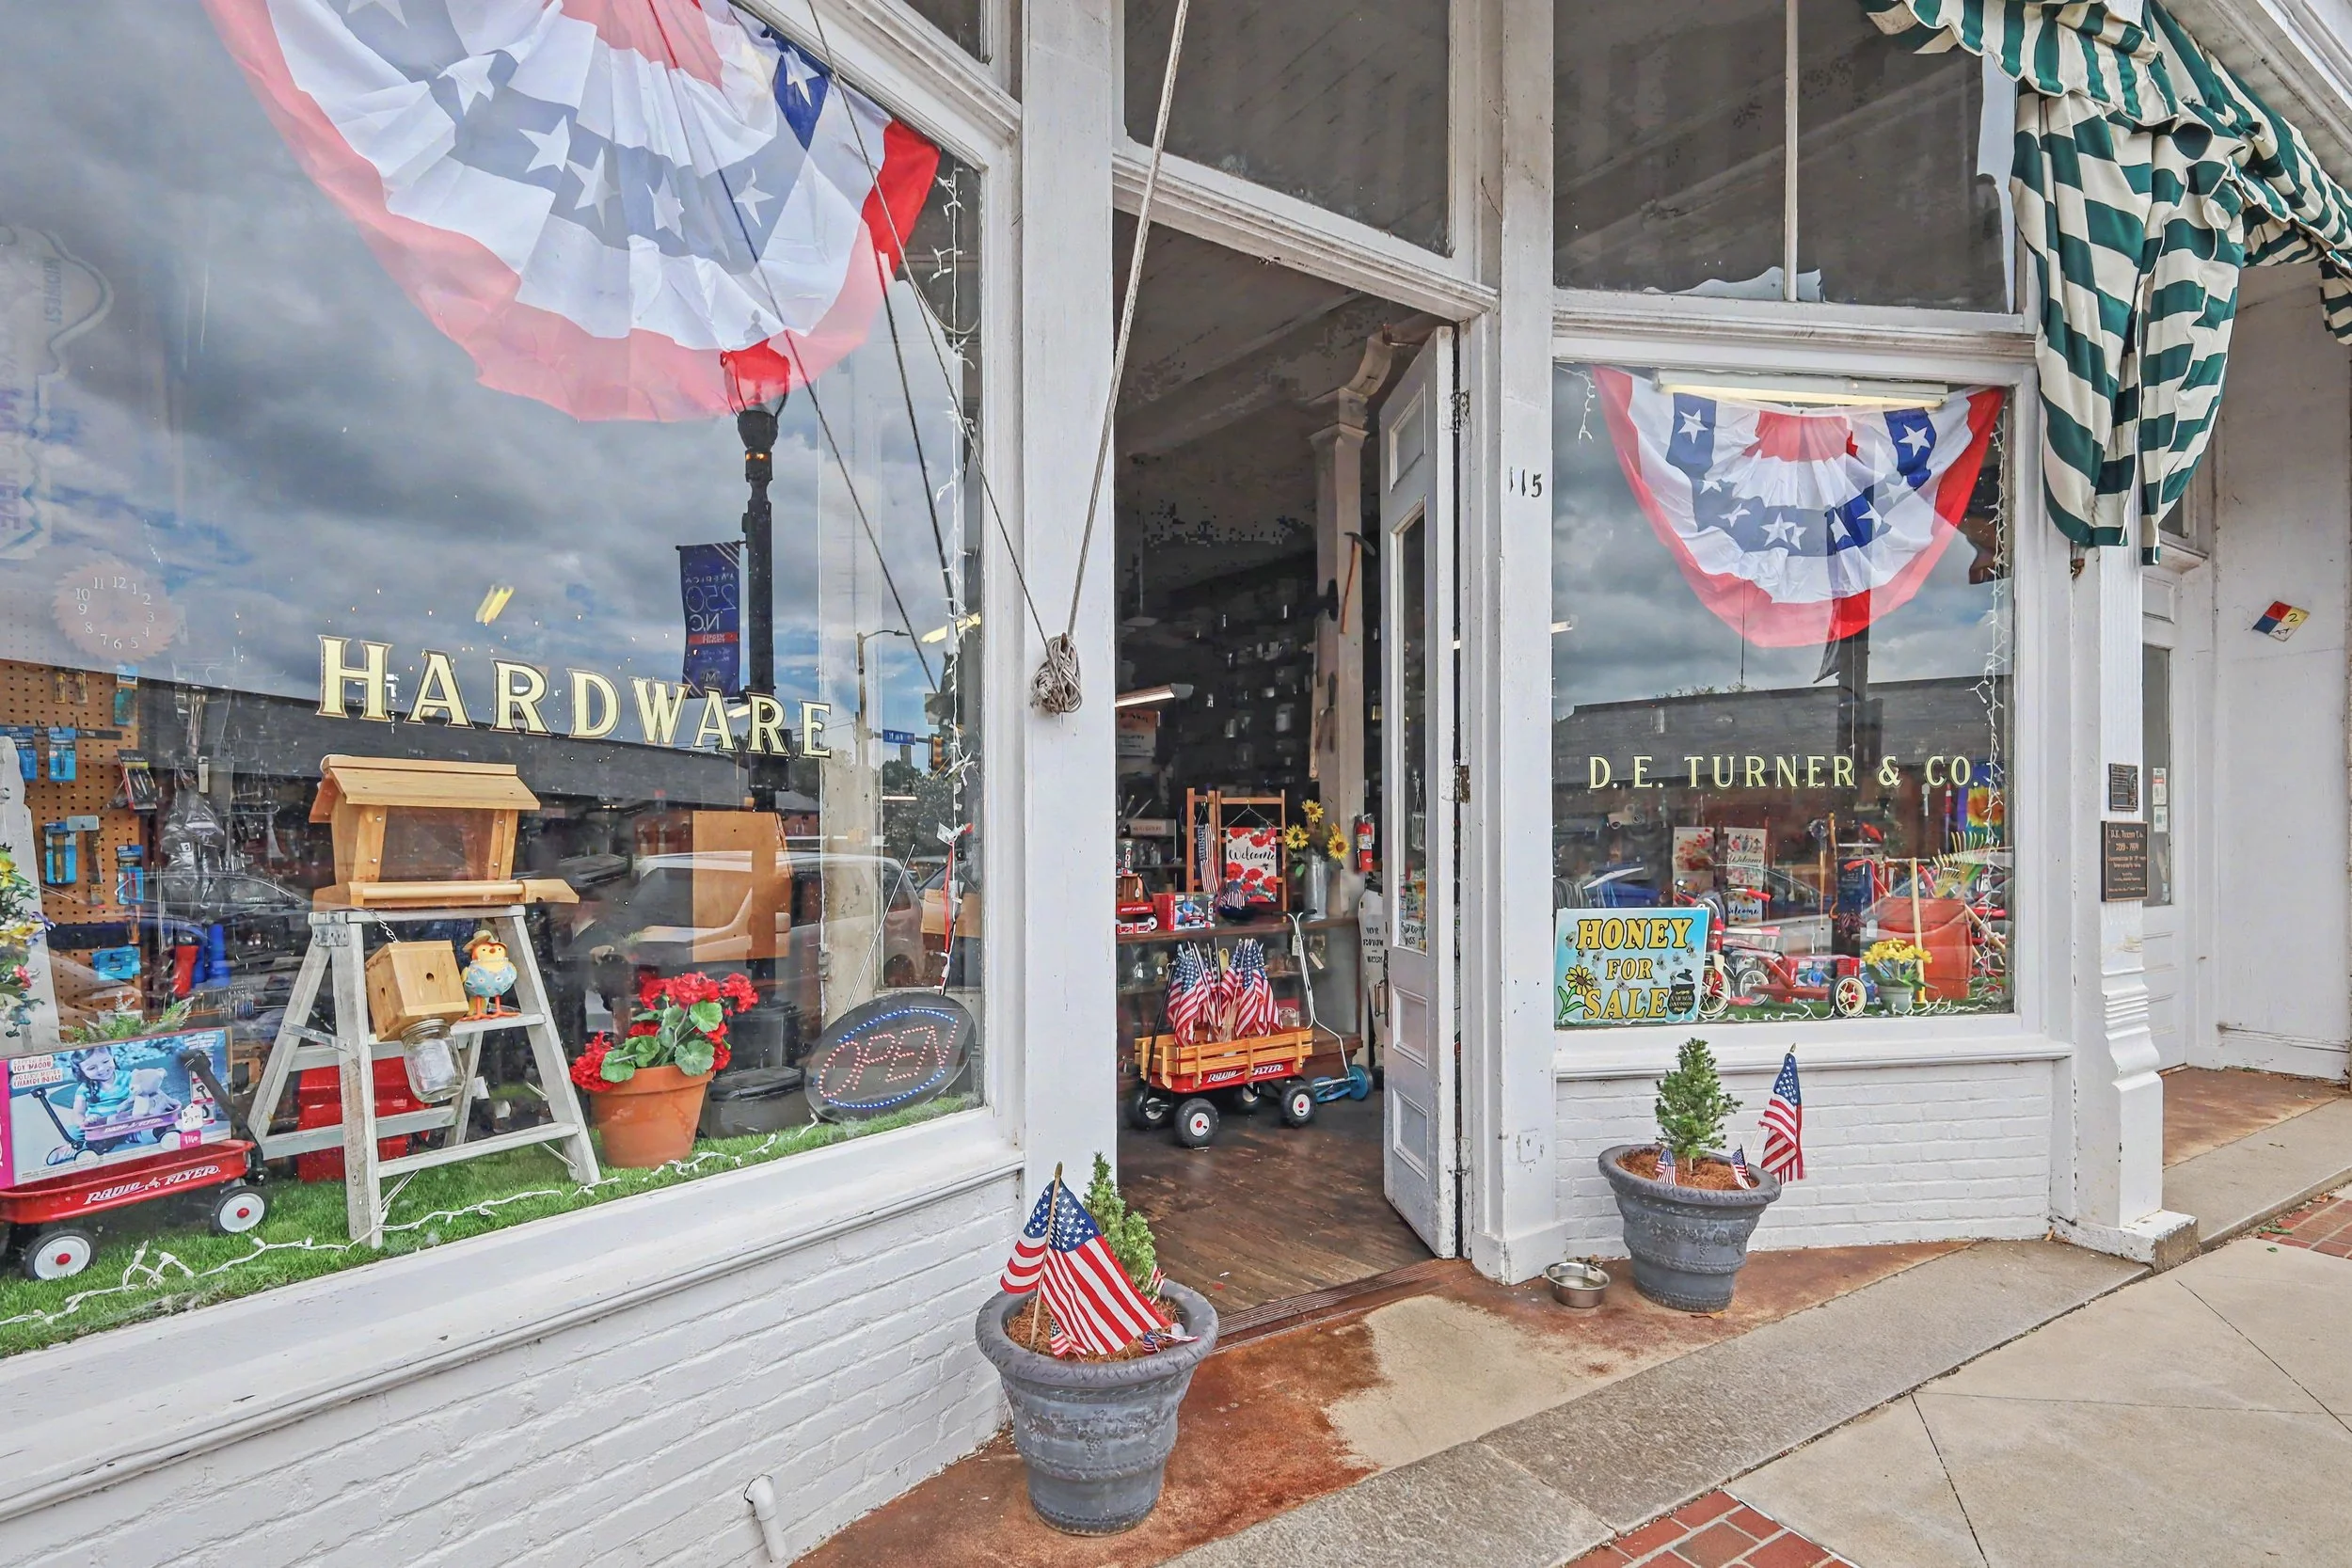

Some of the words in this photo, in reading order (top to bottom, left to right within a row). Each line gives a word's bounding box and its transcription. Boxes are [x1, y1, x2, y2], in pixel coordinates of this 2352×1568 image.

[42, 256, 62, 325] MIDWEST
[1508, 466, 1543, 499] 115
[94, 577, 104, 590] 11
[113, 576, 128, 590] 12
[131, 582, 138, 595] 1
[75, 587, 91, 602] 10
[142, 593, 151, 606] 2
[78, 603, 87, 615] 9
[148, 610, 155, 623] 3
[2288, 612, 2299, 623] 2
[85, 621, 94, 634] 8
[142, 626, 150, 639] 4
[100, 633, 109, 646] 7
[113, 638, 122, 650] 6
[130, 636, 139, 649] 5
[315, 634, 833, 760] HARDWARE
[1682, 753, 1857, 789] TURNER
[1876, 753, 1903, 788] &
[1923, 753, 1979, 788] CO.
[1575, 917, 1694, 950] HONEY
[1605, 958, 1654, 981] FOR
[1582, 987, 1670, 1021] SALE
[818, 1020, 959, 1099] OPEN
[83, 1180, 145, 1206] RADIO
[159, 1164, 221, 1187] FLYER
